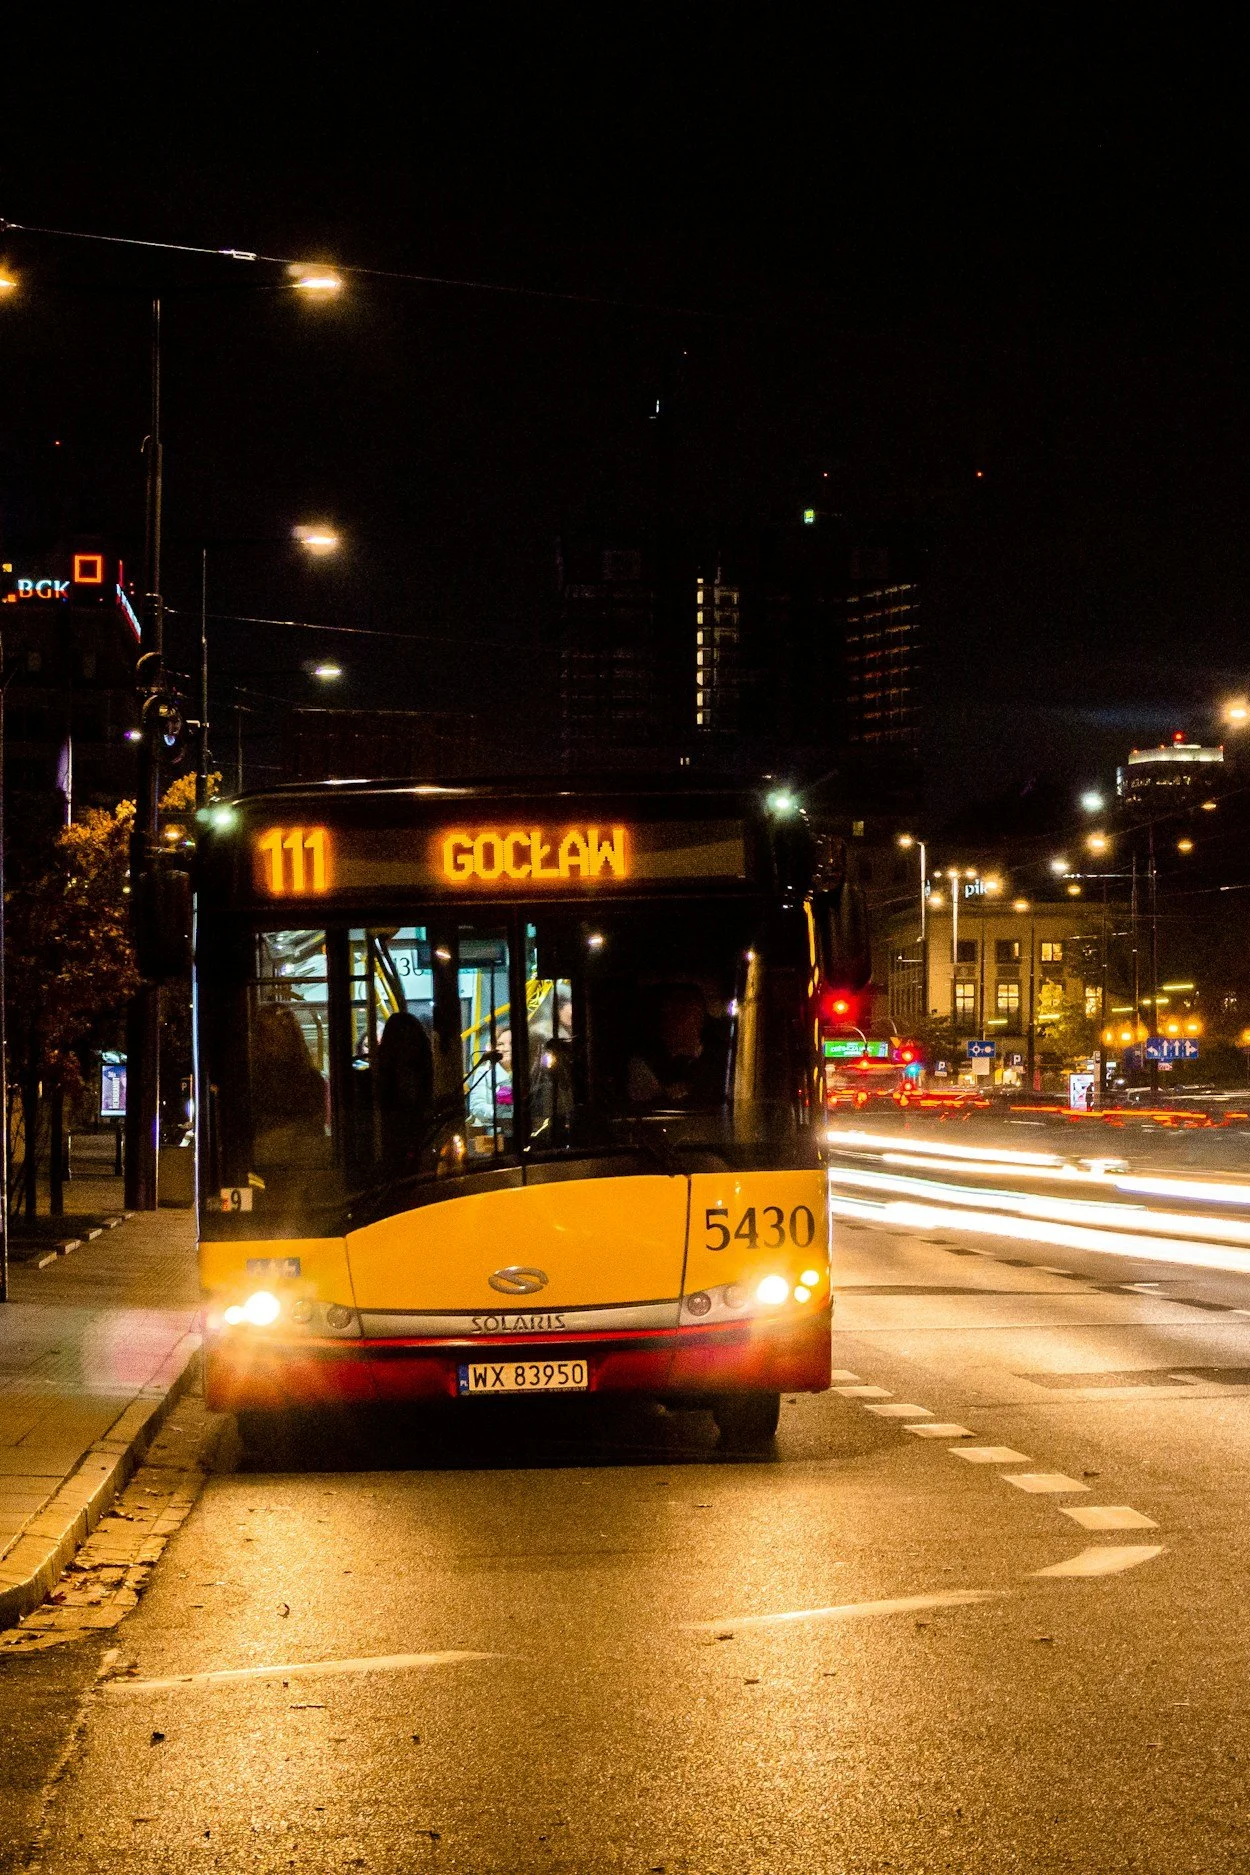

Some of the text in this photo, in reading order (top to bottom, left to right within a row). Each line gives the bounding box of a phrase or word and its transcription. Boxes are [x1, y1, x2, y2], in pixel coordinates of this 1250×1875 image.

[18, 579, 70, 598] BGK
[259, 828, 626, 893] 111 GOCŁAW
[938, 1061, 946, 1071] P
[1013, 1055, 1021, 1065] P
[231, 1189, 242, 1211] 9
[705, 1205, 815, 1251] 5430
[472, 1314, 566, 1332] SOLARIS
[473, 1366, 505, 1388] WX
[514, 1363, 584, 1387] 83950
